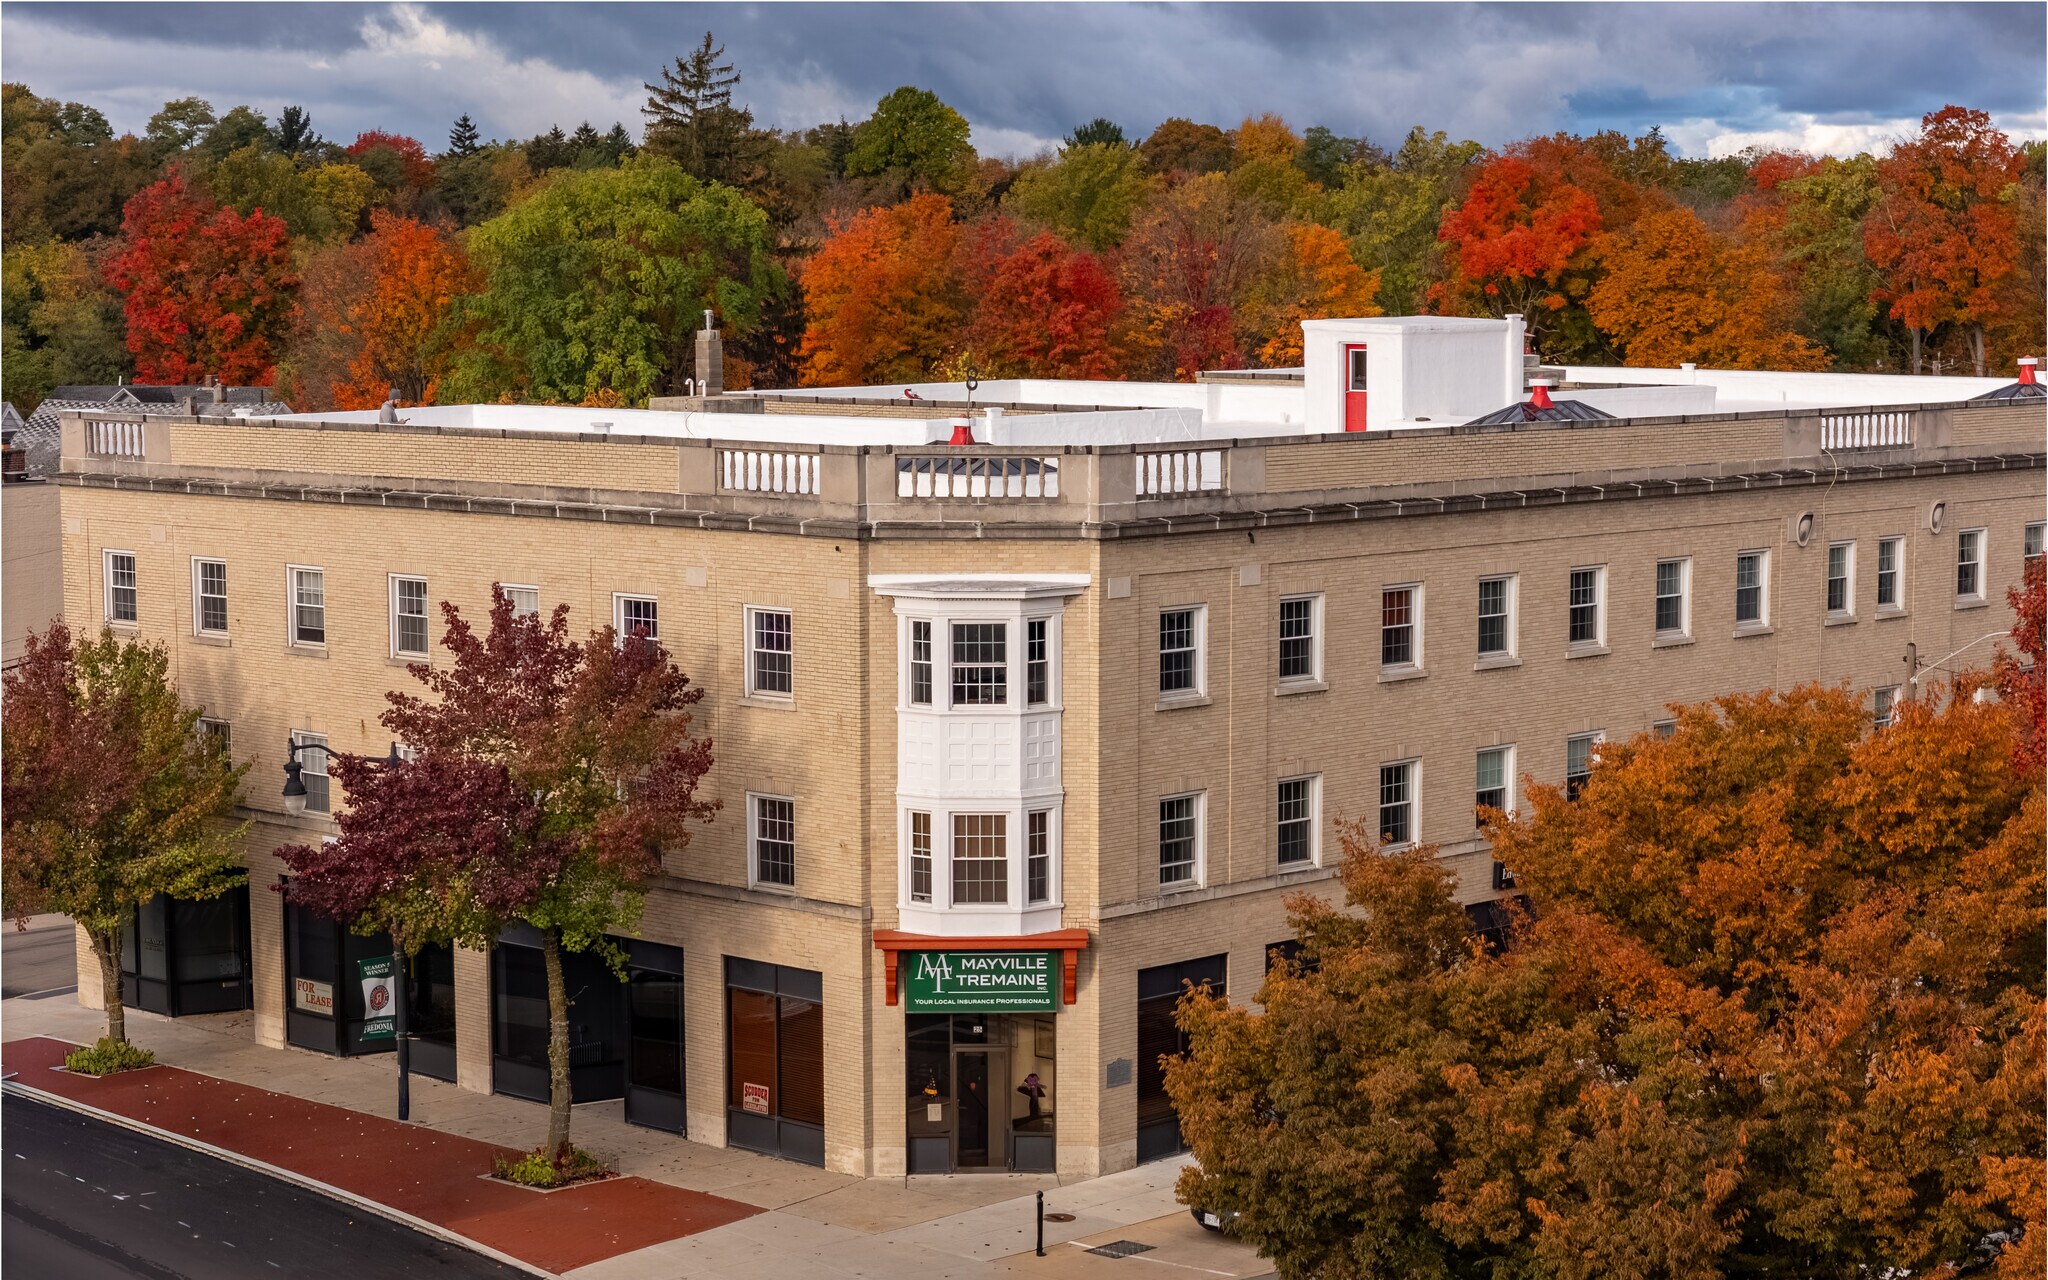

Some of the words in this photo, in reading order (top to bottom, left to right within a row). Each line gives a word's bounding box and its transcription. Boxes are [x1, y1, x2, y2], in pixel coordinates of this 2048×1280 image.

[364, 963, 386, 972] SEASON
[961, 958, 1047, 969] MAYVILLE
[956, 974, 1047, 986] TREMAINE
[297, 980, 315, 993] FOR
[305, 993, 331, 1007] LEASE
[364, 1023, 394, 1033] FREDONIA
[745, 1085, 767, 1102] SCUDDER
